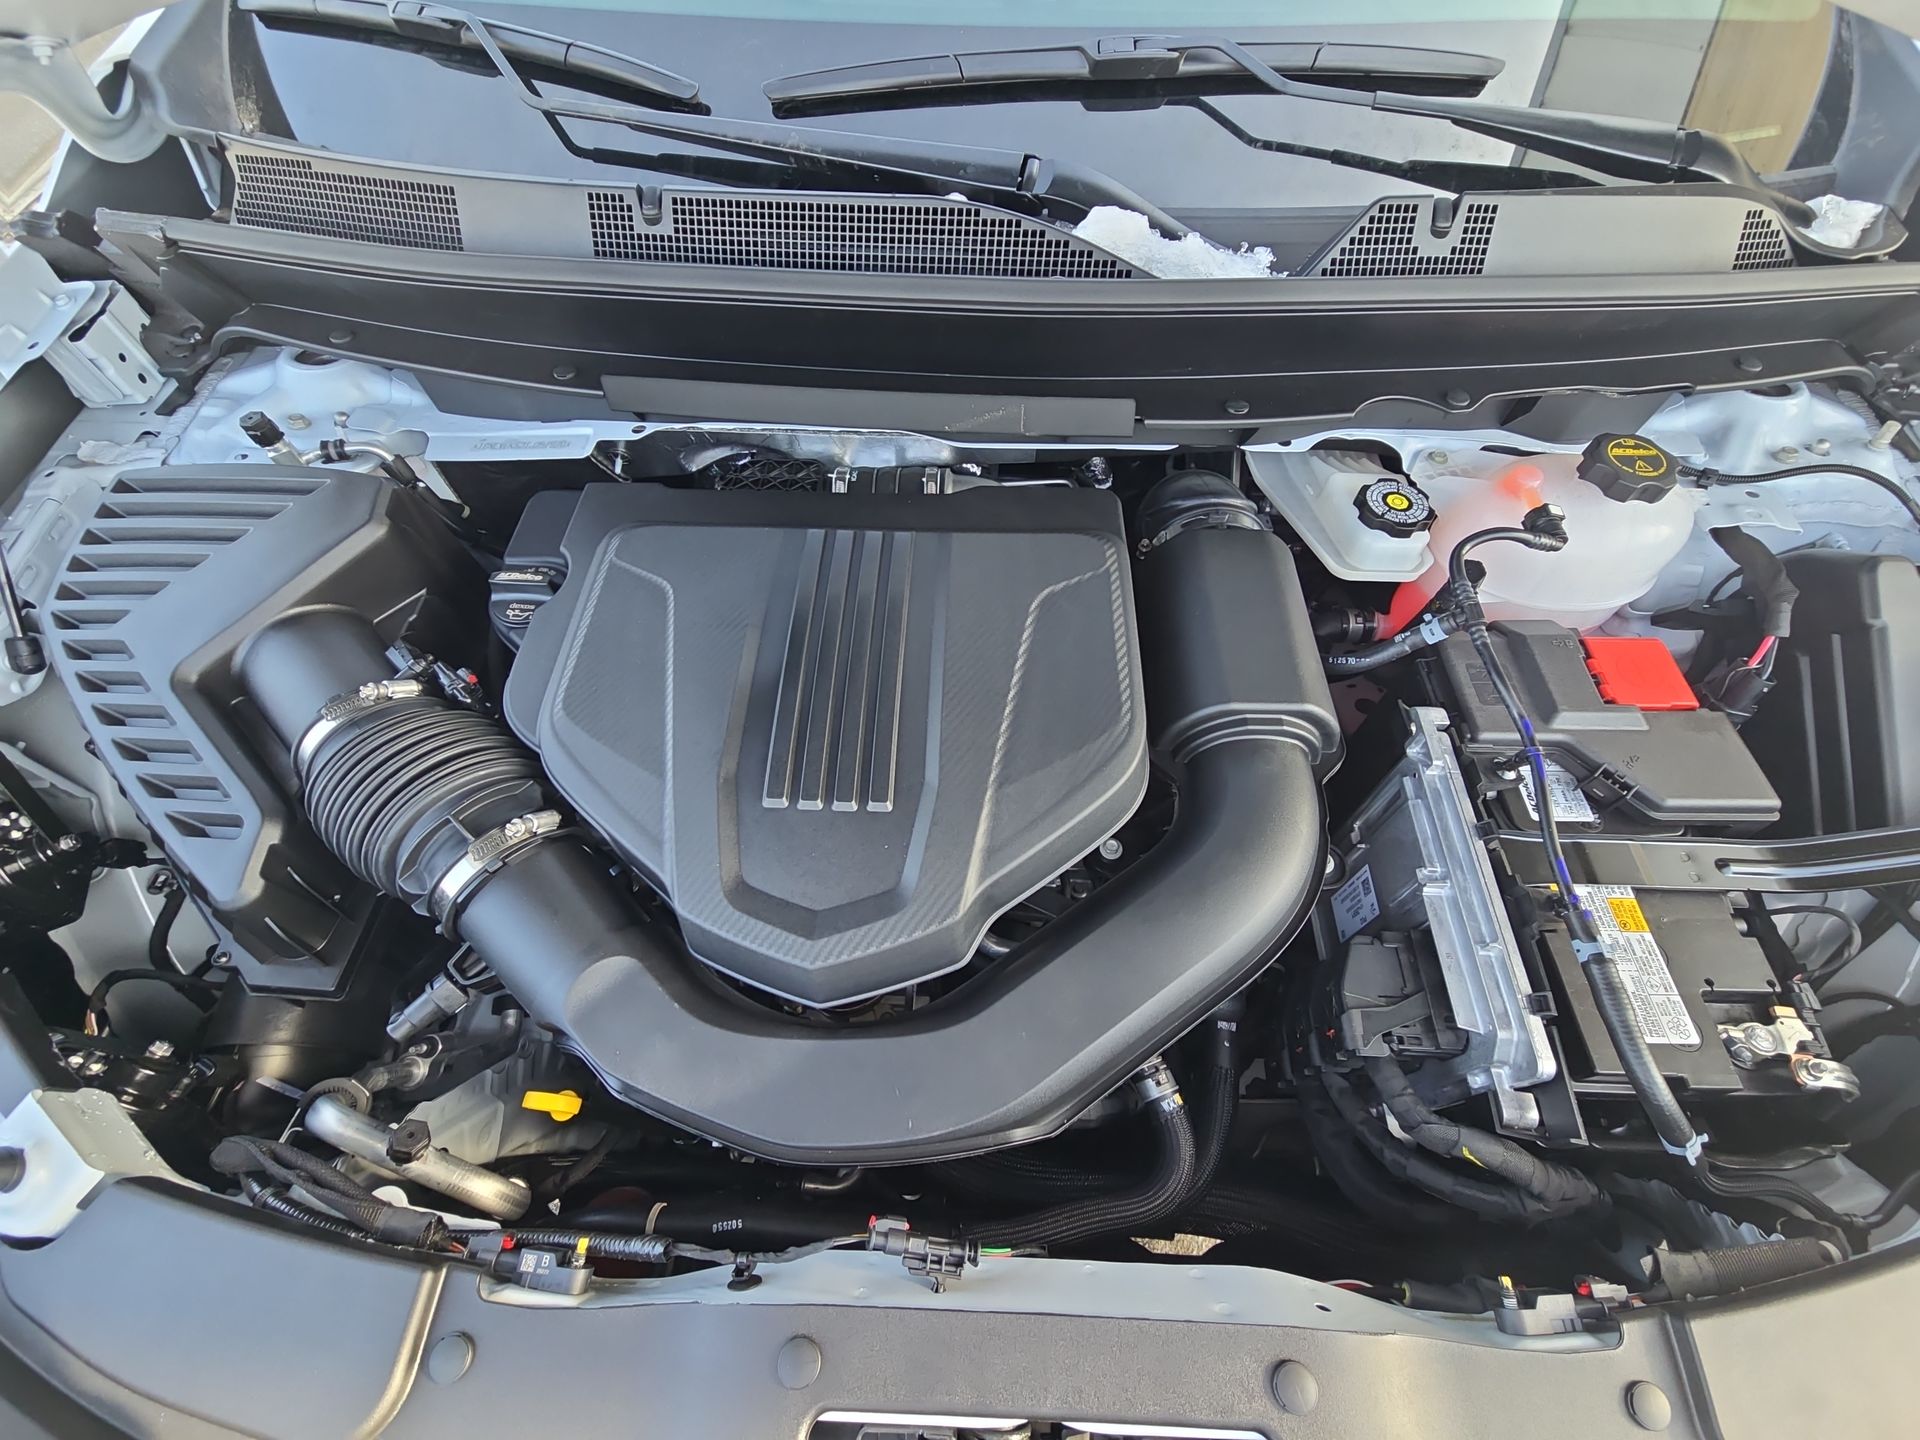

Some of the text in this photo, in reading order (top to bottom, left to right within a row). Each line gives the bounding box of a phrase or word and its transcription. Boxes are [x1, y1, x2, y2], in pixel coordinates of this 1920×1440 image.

[1611, 448, 1657, 456] ACDelco
[494, 572, 543, 581] ACDelco
[542, 1255, 550, 1267] B
